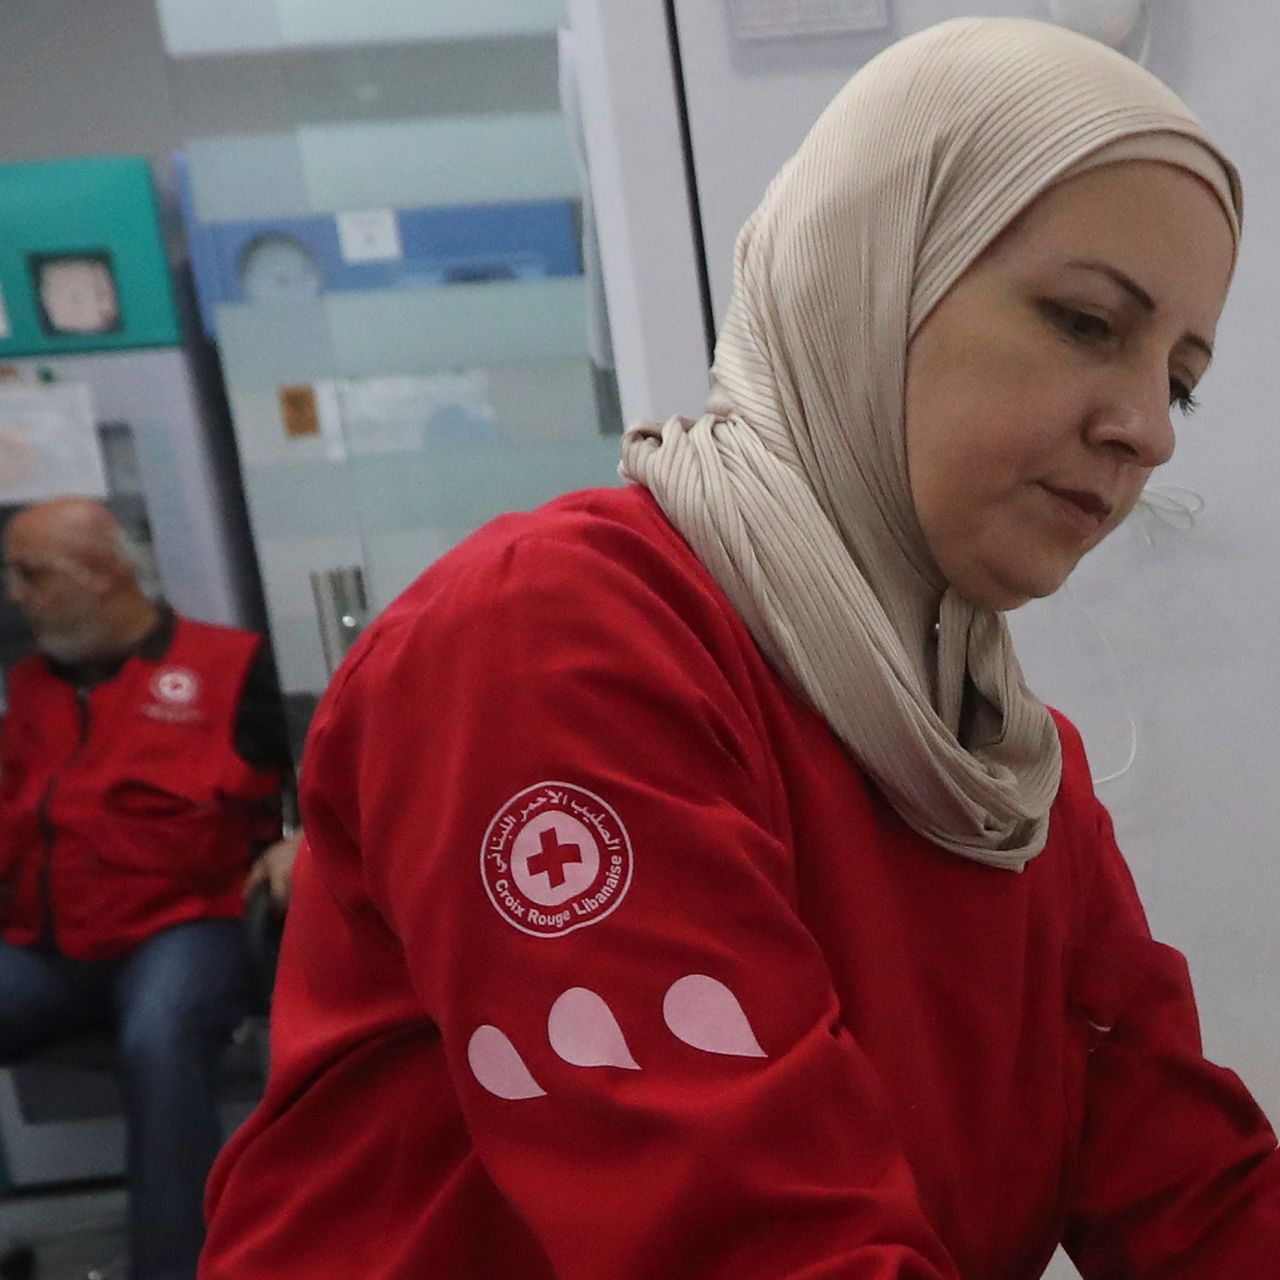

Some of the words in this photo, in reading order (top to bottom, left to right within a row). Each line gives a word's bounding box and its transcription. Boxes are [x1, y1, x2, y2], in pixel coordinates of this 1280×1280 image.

[487, 815, 517, 873] اللبناني
[571, 799, 621, 850] الصليب
[495, 879, 525, 917] Croix
[527, 908, 571, 928] Rouge
[572, 854, 622, 915] Libanaise
